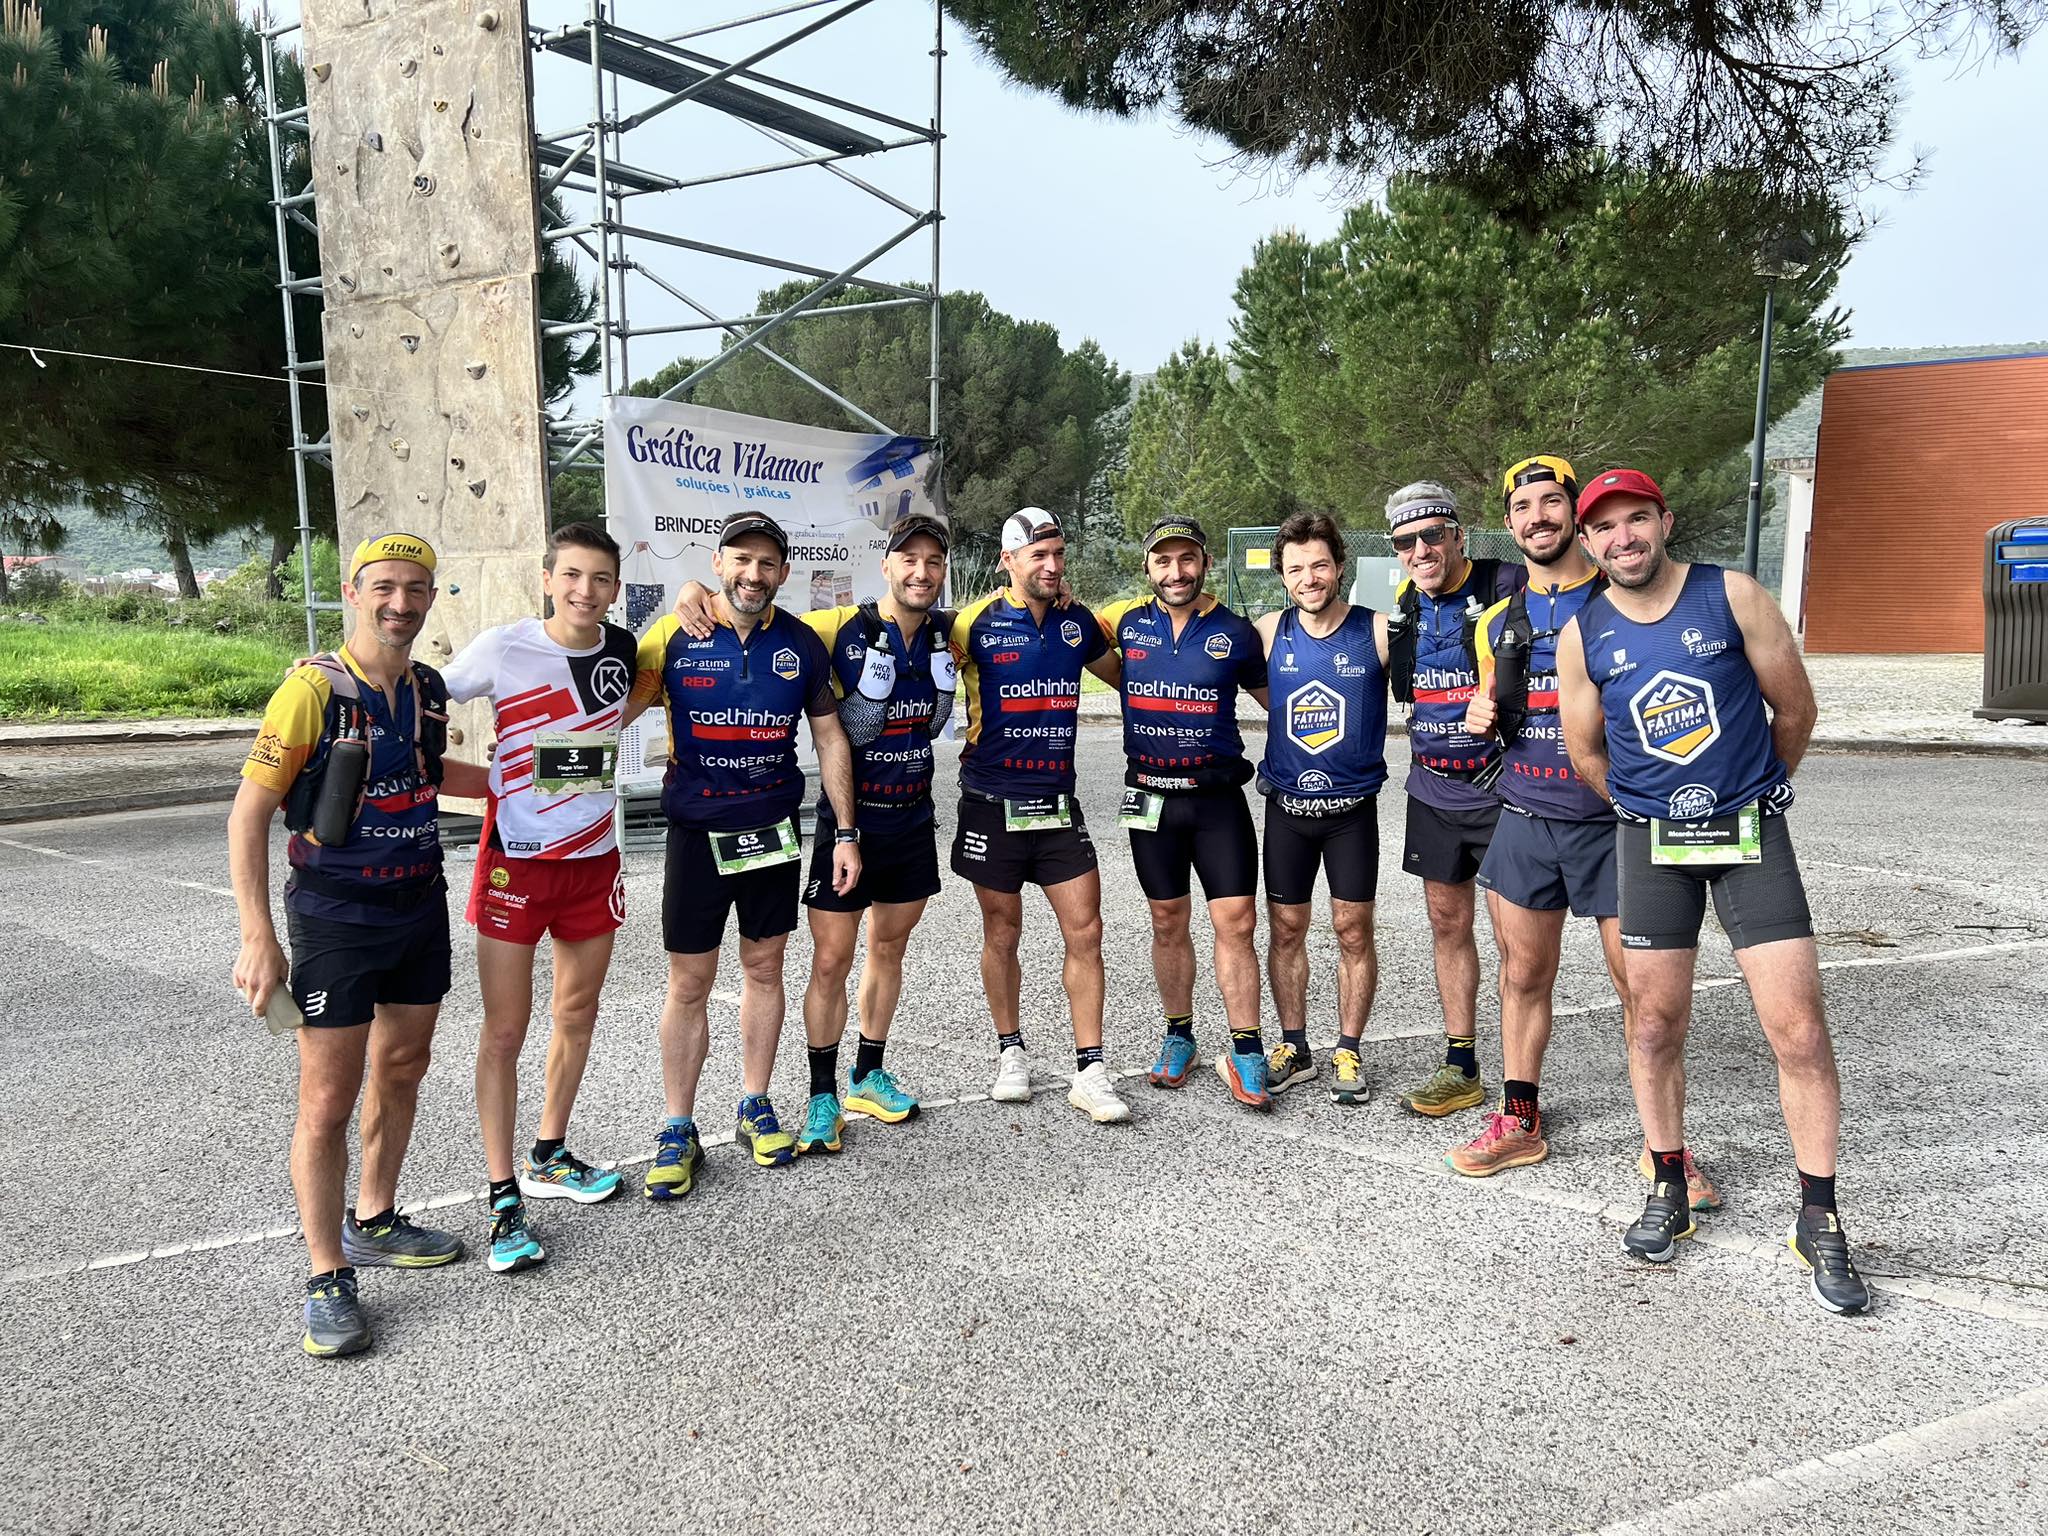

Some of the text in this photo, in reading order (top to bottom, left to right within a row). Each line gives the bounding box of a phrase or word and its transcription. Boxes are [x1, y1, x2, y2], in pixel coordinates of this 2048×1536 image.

[627, 424, 824, 484] Gráfica Vilamor
[676, 476, 792, 500] soluções gráficas
[655, 515, 722, 534] BRINDES
[382, 541, 423, 555] FÁTIMA
[869, 539, 888, 550] FARD
[788, 543, 849, 561] PRESSÃO
[996, 635, 1030, 645] Fátima
[1688, 639, 1728, 655] Fátima
[993, 651, 1020, 664] RED
[1336, 665, 1366, 674] Fátima
[1609, 662, 1638, 676] Ourém
[683, 676, 718, 688] RED
[1127, 680, 1219, 701] coelhinhos
[1175, 702, 1214, 713] trucks
[690, 708, 794, 727] coelhinhos
[1294, 711, 1338, 725] FÁTIMA
[1646, 703, 1706, 734] FÁTIMA
[751, 728, 786, 739] trucks
[1133, 723, 1213, 738] ECONSERGE
[1654, 718, 1702, 738] TRAIL TEAM
[568, 749, 580, 763] 3
[1125, 791, 1136, 803] 75
[1676, 796, 1711, 810] TRAIL
[738, 833, 759, 847] 63
[1695, 830, 1730, 839] Gonçalves
